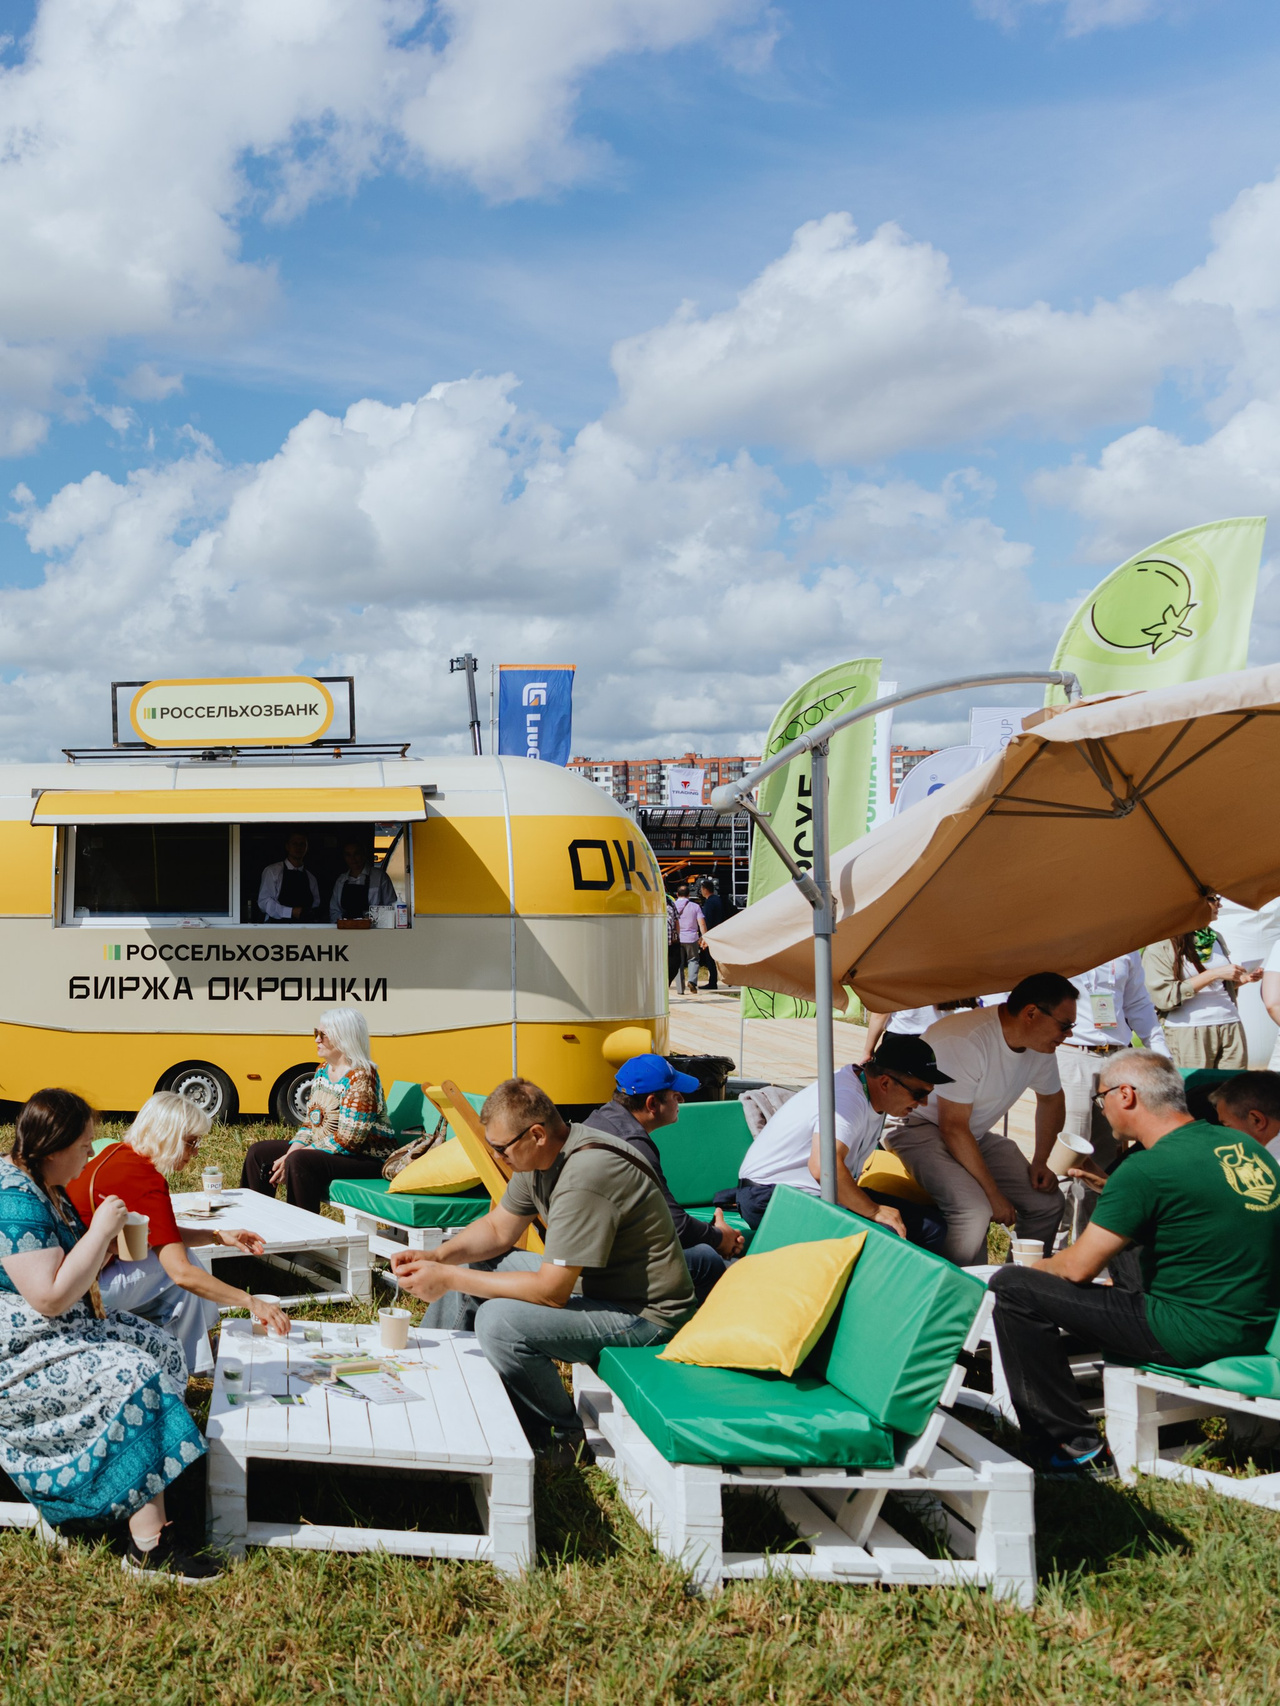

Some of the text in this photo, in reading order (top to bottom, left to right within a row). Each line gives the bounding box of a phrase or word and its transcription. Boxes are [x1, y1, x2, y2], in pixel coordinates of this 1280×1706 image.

[160, 703, 319, 719] РОССЕЛЬХОЗБАНК
[126, 944, 350, 962] РОССЕЛЬХОЗБАНК
[69, 976, 387, 1002] БИРЖА ОКРОШКИ
